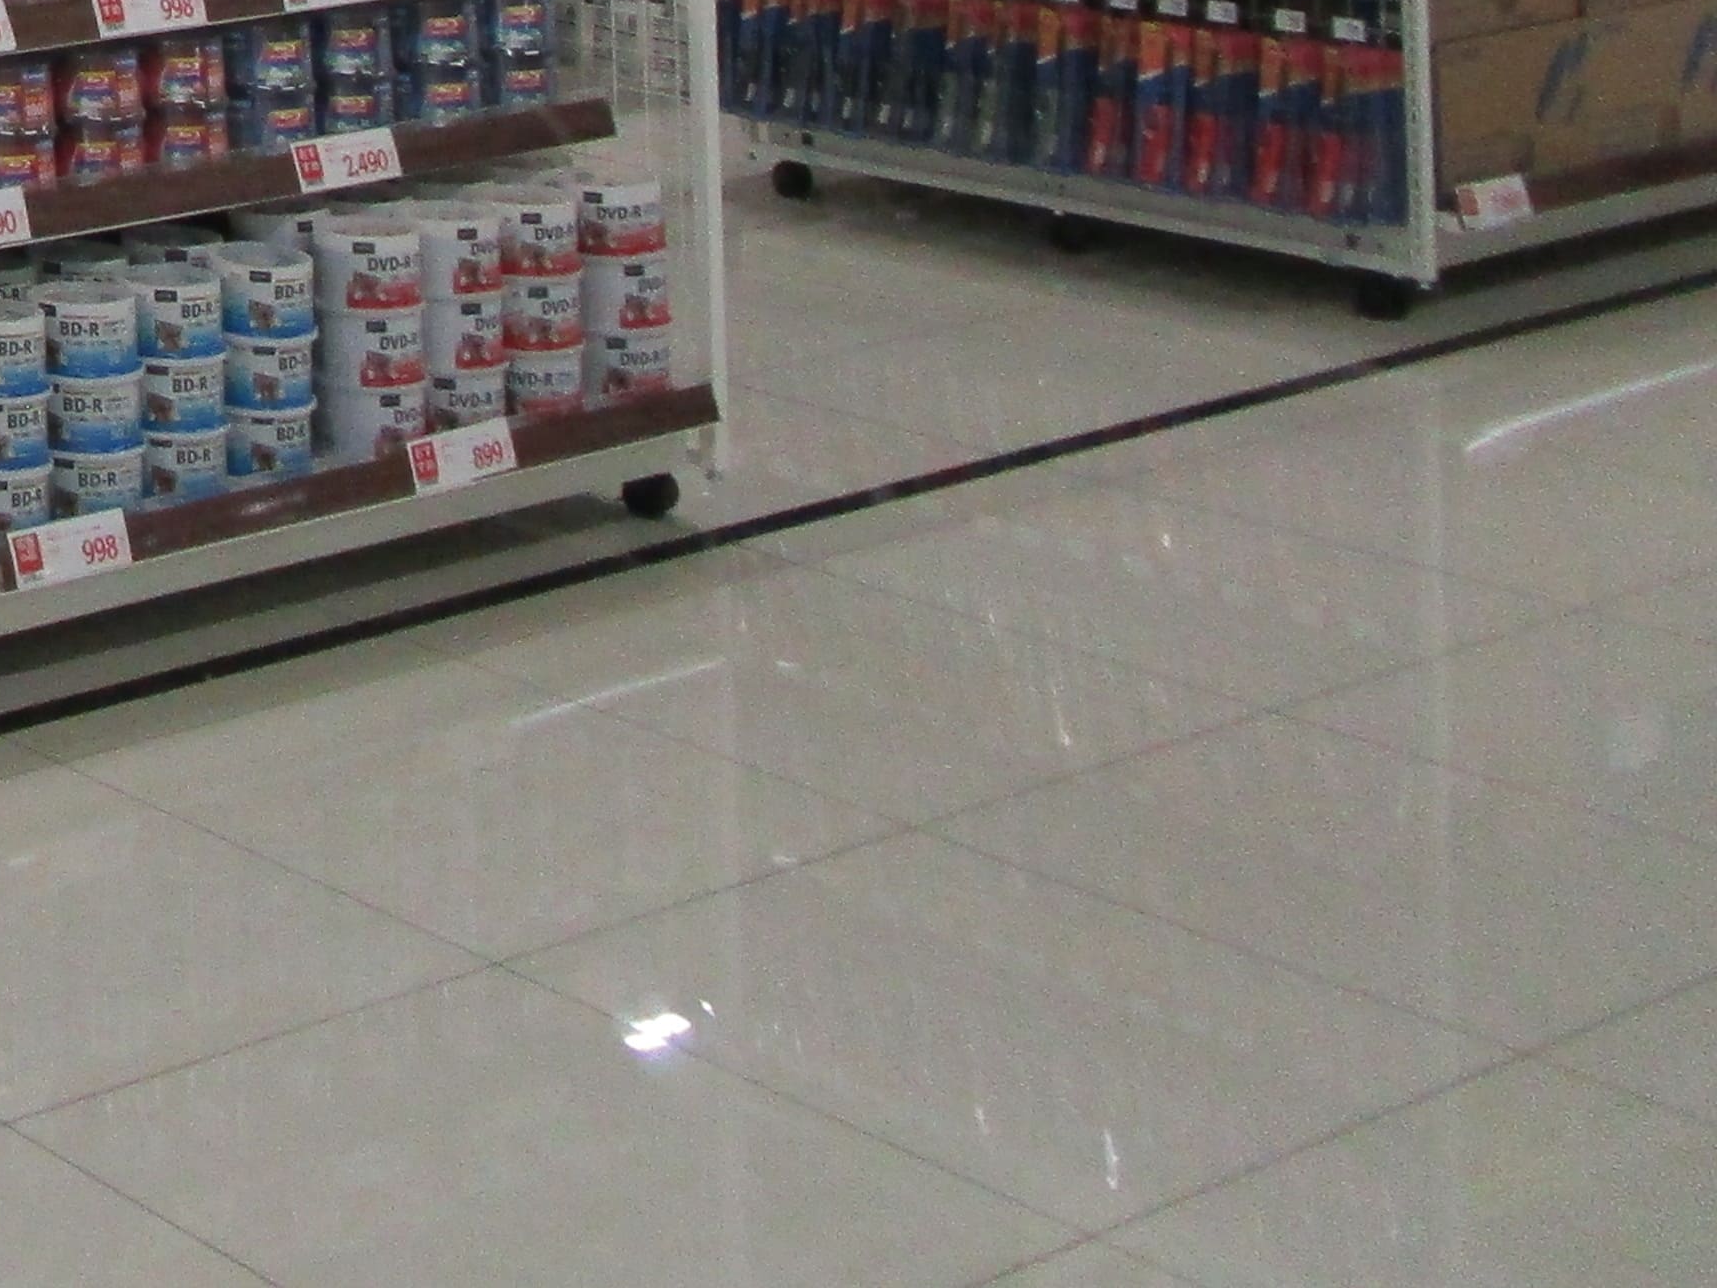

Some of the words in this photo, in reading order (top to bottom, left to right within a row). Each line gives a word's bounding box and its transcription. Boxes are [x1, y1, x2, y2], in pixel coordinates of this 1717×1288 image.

[60, 322, 100, 337] BD-R
[172, 376, 208, 393] BD-R
[64, 398, 103, 413] BD-R
[82, 535, 118, 564] 998
